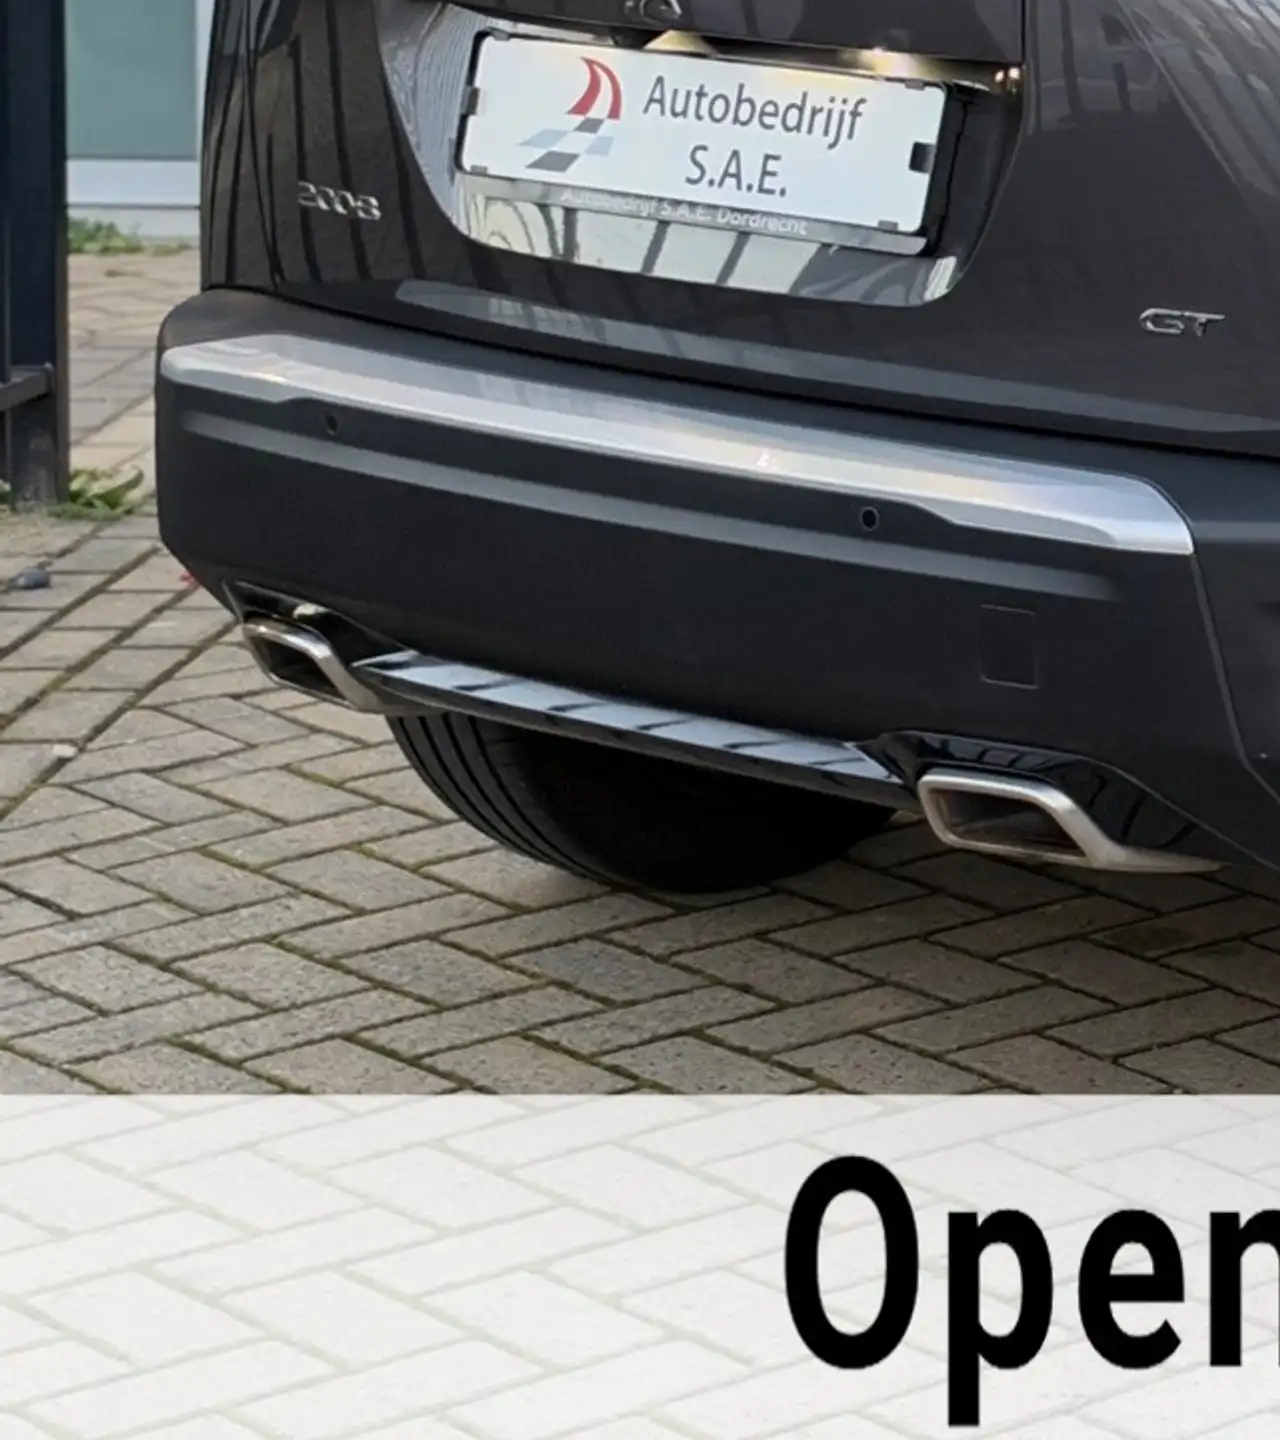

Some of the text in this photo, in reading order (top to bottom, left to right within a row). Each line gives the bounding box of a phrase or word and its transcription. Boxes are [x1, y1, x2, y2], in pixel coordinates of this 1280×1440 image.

[642, 74, 868, 150] Autobedrijf
[684, 144, 788, 199] S.A.E.
[297, 181, 382, 221] 2008
[716, 207, 808, 236] Dordrecht
[1139, 307, 1227, 337] GT
